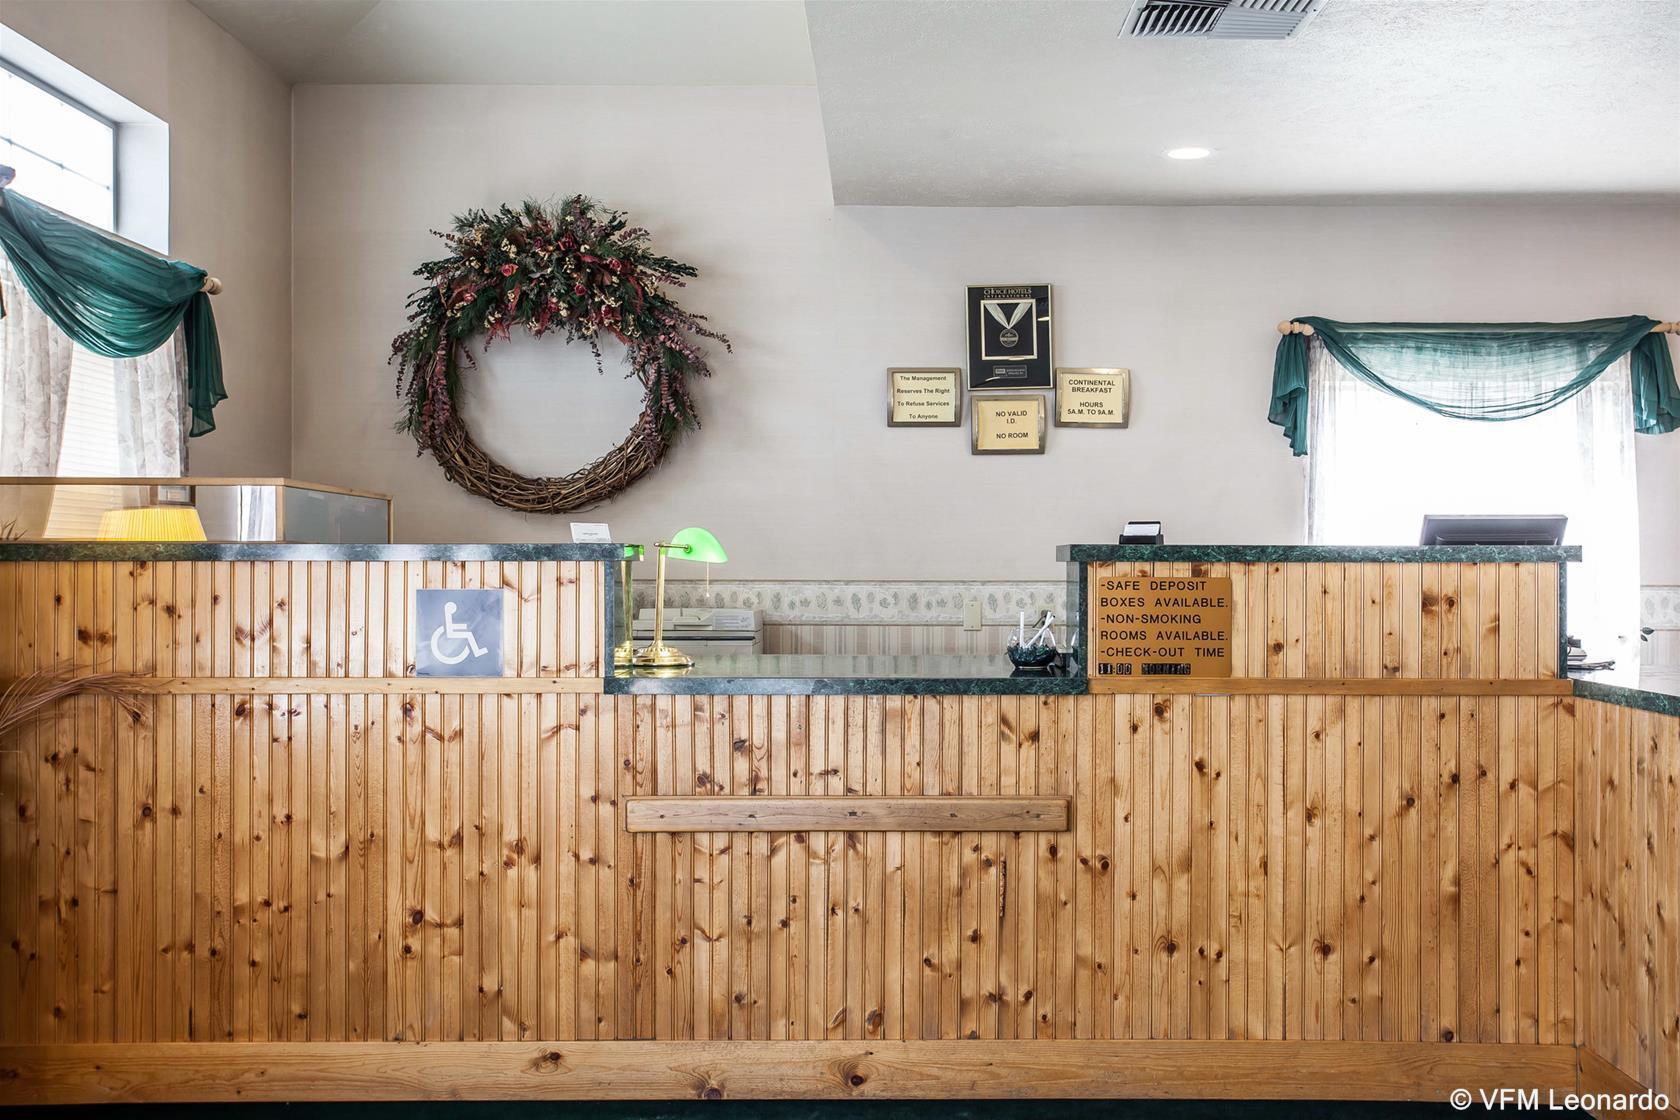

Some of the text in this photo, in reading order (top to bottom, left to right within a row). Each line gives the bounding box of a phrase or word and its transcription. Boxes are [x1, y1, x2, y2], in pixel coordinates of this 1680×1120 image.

[1101, 581, 1207, 591] -SAFE DEPOSIT
[1100, 598, 1228, 608] BOXES AVAILABLE.
[1101, 614, 1201, 624] -NON-SMOKING
[1100, 631, 1228, 640] ROOMS AVAILABLE.
[1101, 647, 1224, 657] -CHECK-OUT TIME
[1099, 664, 1132, 674] 11:00
